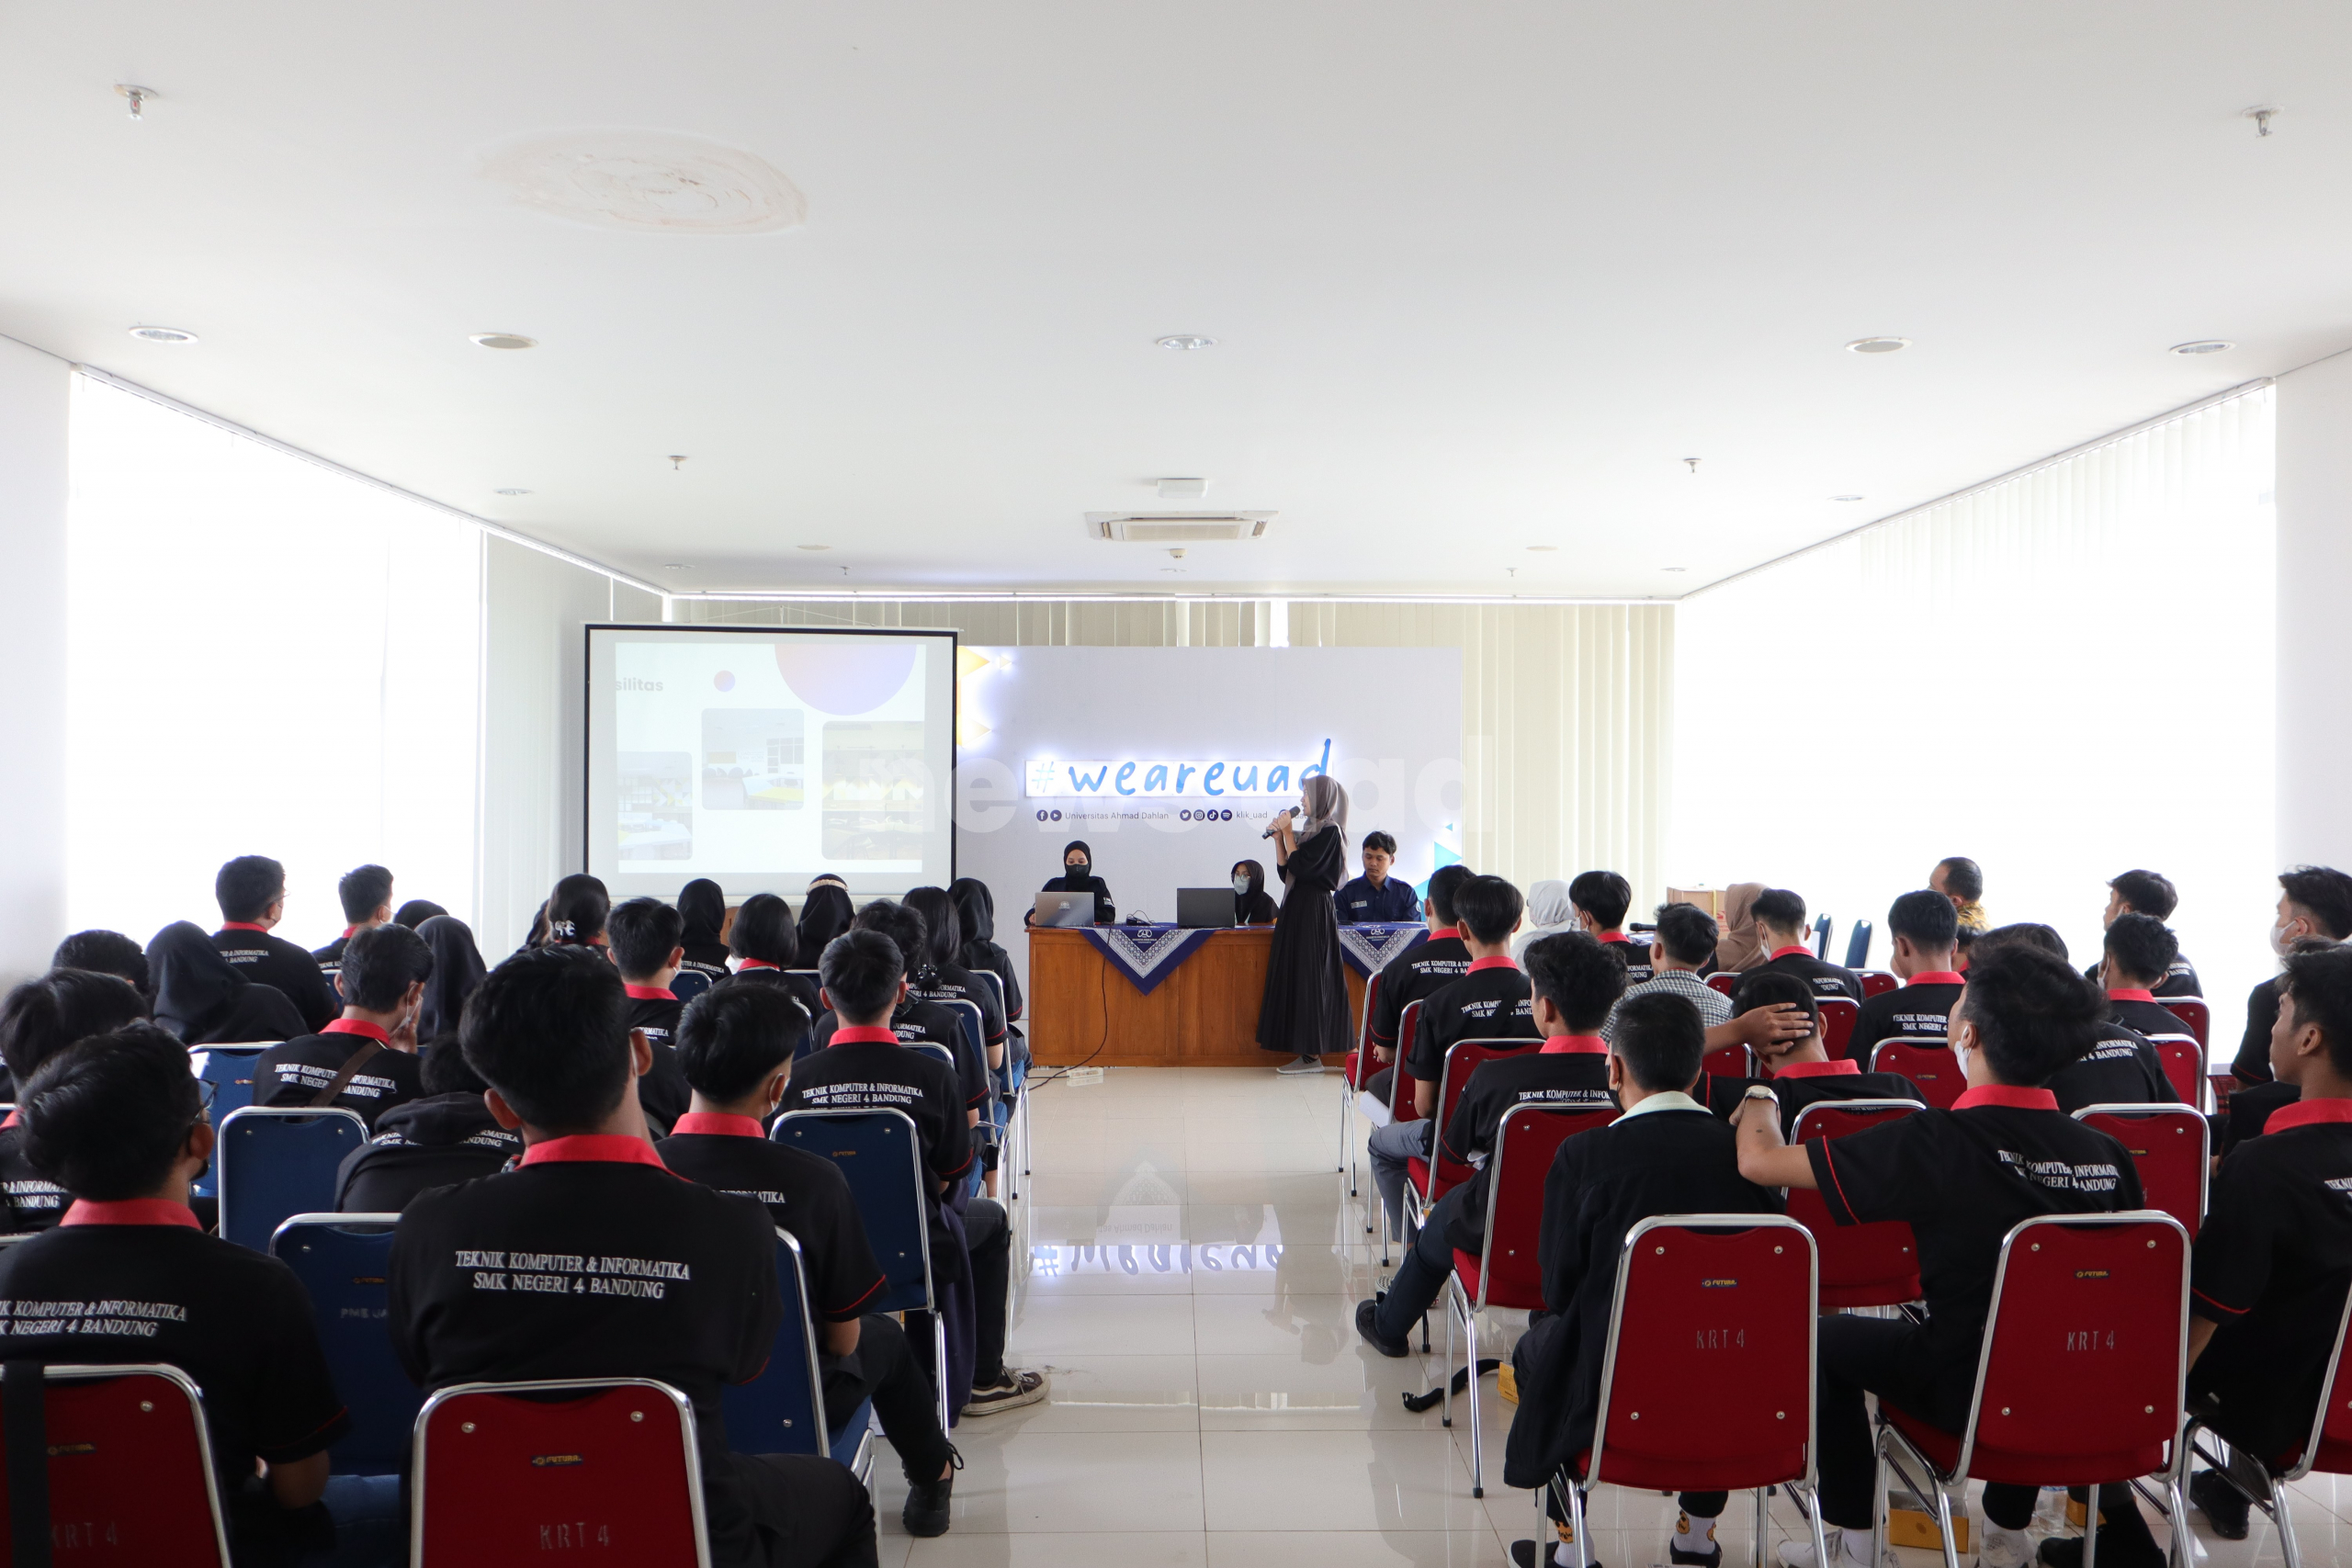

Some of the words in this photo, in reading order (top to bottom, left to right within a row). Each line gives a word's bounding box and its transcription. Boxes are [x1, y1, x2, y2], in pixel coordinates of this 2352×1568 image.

[615, 677, 663, 691] silitas
[1032, 738, 1332, 796] #weareuad
[1236, 811, 1268, 820] klik_uad
[1411, 961, 1430, 969] TEKNIK
[1461, 1001, 1483, 1013] TEKNIK
[1515, 1008, 1532, 1016] BAND
[1893, 1014, 1916, 1022] TEKNIK
[1917, 1014, 1948, 1023] KOMPUTER
[1902, 1022, 1917, 1031] SMK
[893, 1031, 915, 1040] NDUNG
[2095, 1048, 2133, 1060] BANDUNG
[275, 1063, 301, 1073] TEKNIK
[300, 1065, 339, 1079] KOMPUTE
[349, 1074, 397, 1089] NFORMATIKA
[280, 1073, 300, 1084] SMK
[300, 1076, 330, 1089] NEGER
[802, 1086, 829, 1099] TEKNIK
[829, 1083, 868, 1094] KOMPUTER
[869, 1083, 876, 1092] &
[876, 1083, 923, 1098] INFORMATIKA
[1519, 1090, 1544, 1100] TEKNIK
[1545, 1089, 1582, 1099] KOMPUTER
[1582, 1089, 1589, 1098] &
[811, 1095, 829, 1104] SMK
[831, 1094, 862, 1103] NEGERI
[863, 1094, 870, 1103] 4
[872, 1094, 912, 1104] BANDUNG
[459, 1137, 503, 1147] NDUNG
[2030, 1173, 2069, 1188] NEGERI
[2080, 1178, 2117, 1192] ANDUNG
[14, 1195, 61, 1209] BANDUNG
[456, 1250, 506, 1269] TEKNIK
[508, 1252, 583, 1272] KOMPUTER
[585, 1256, 598, 1272] &
[599, 1257, 690, 1280] INFORMATIKA
[473, 1271, 507, 1290] SMK
[512, 1274, 570, 1293] NEGERI
[572, 1278, 585, 1293] 4
[589, 1277, 665, 1299] BANDUNG
[12, 1301, 85, 1316] KOMPUTER
[85, 1303, 96, 1316] &
[96, 1301, 187, 1321] INFORMATIKA
[10, 1319, 66, 1335] NEGERI
[65, 1319, 79, 1333] 4
[79, 1319, 160, 1337] BANDUNG
[1696, 1329, 1728, 1348] KRT
[1736, 1328, 1745, 1348] 4
[2067, 1330, 2099, 1351] KRT
[2106, 1330, 2114, 1350] 4
[539, 1522, 585, 1550] KRT
[597, 1524, 609, 1547] 4
